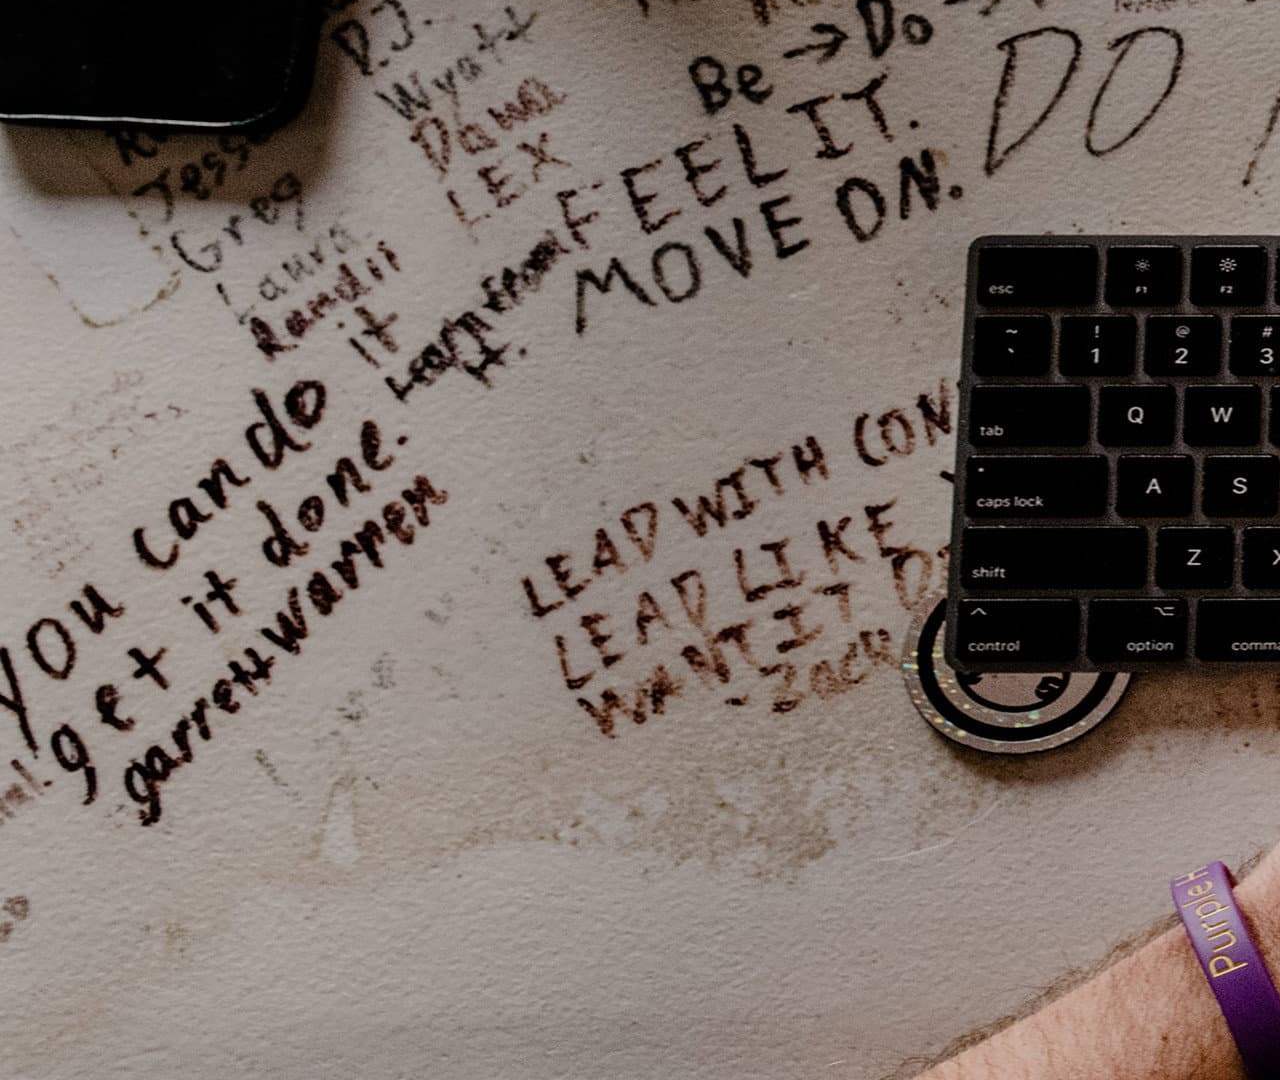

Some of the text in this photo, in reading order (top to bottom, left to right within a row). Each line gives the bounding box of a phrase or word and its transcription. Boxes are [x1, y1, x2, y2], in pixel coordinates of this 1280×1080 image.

[374, 4, 542, 123] Wyatt
[687, 54, 777, 118] Be
[983, 25, 1185, 177] DO
[445, 129, 573, 246] LEX
[555, 67, 922, 252] FEEL IT.
[170, 170, 306, 274] Greg
[573, 147, 966, 337] MOVE ON.
[215, 222, 359, 326] Laura
[988, 283, 1015, 296] esc
[979, 424, 1004, 437] tab
[1126, 404, 1234, 424] Q W
[132, 456, 251, 571] can
[245, 378, 328, 471] do
[975, 494, 1044, 511] caps lock
[1145, 477, 1162, 494] A
[520, 501, 660, 619] LEAD
[671, 434, 830, 539] WITH
[971, 565, 1006, 579] shift
[1187, 548, 1202, 566] Z
[49, 419, 410, 807] get it done.
[553, 496, 867, 691] LEAD LIKE
[967, 638, 1021, 653] control
[1126, 638, 1174, 654] option
[1183, 881, 1249, 978] Purple
